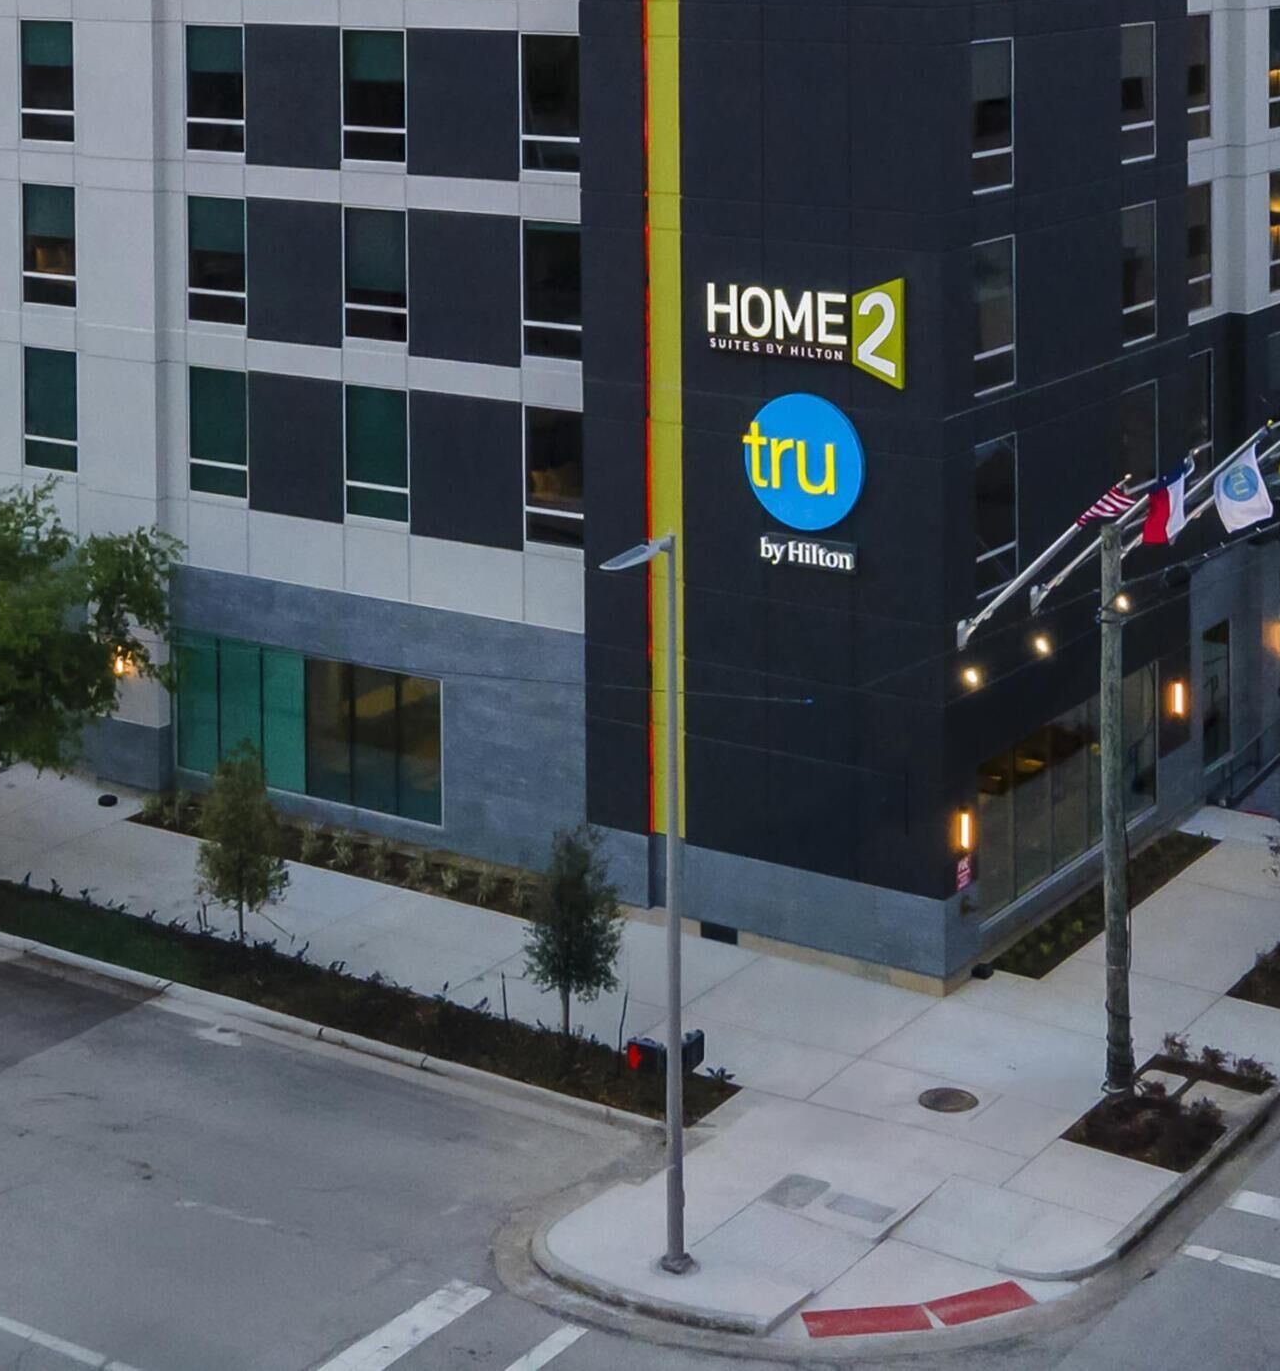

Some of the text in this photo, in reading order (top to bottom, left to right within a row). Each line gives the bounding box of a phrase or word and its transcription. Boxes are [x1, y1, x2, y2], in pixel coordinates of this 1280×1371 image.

[706, 282, 896, 378] HOME 2
[709, 337, 844, 361] SUITES BY HILTON
[742, 421, 837, 496] tru
[760, 535, 855, 570] by Hilton
